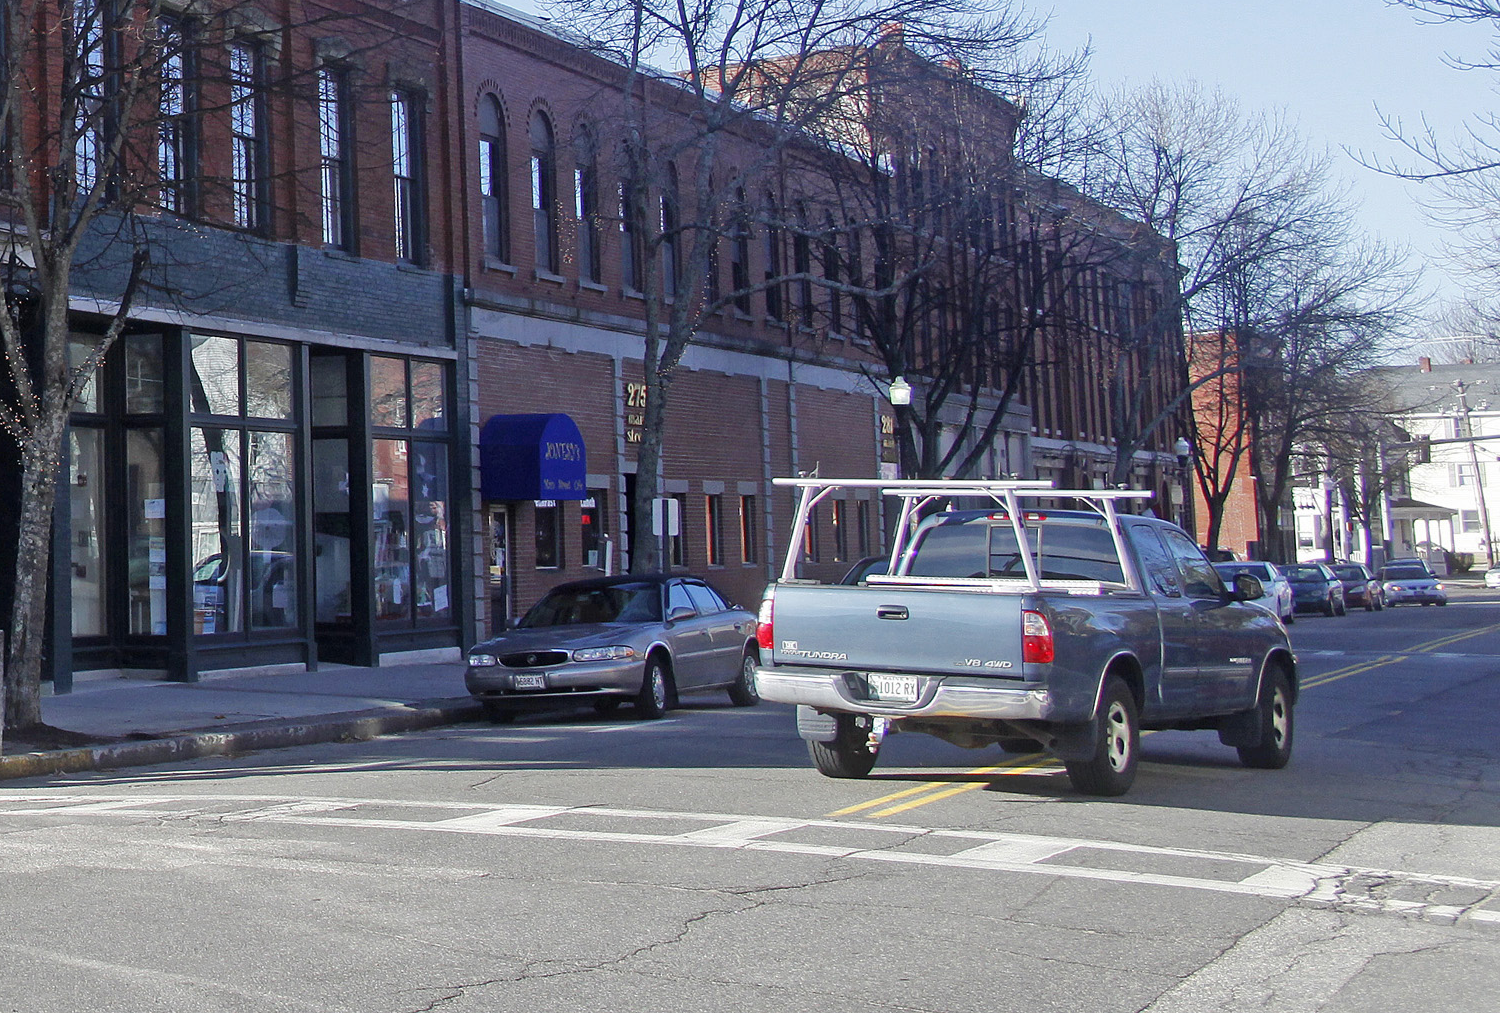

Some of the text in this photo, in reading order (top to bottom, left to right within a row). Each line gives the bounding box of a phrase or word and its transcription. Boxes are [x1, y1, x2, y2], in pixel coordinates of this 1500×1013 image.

[627, 382, 647, 408] 275
[628, 412, 643, 425] mai
[799, 650, 848, 660] TUNDRA
[964, 658, 982, 667] V8
[984, 660, 1013, 668] 4WD
[879, 681, 915, 696] 1012 RX
